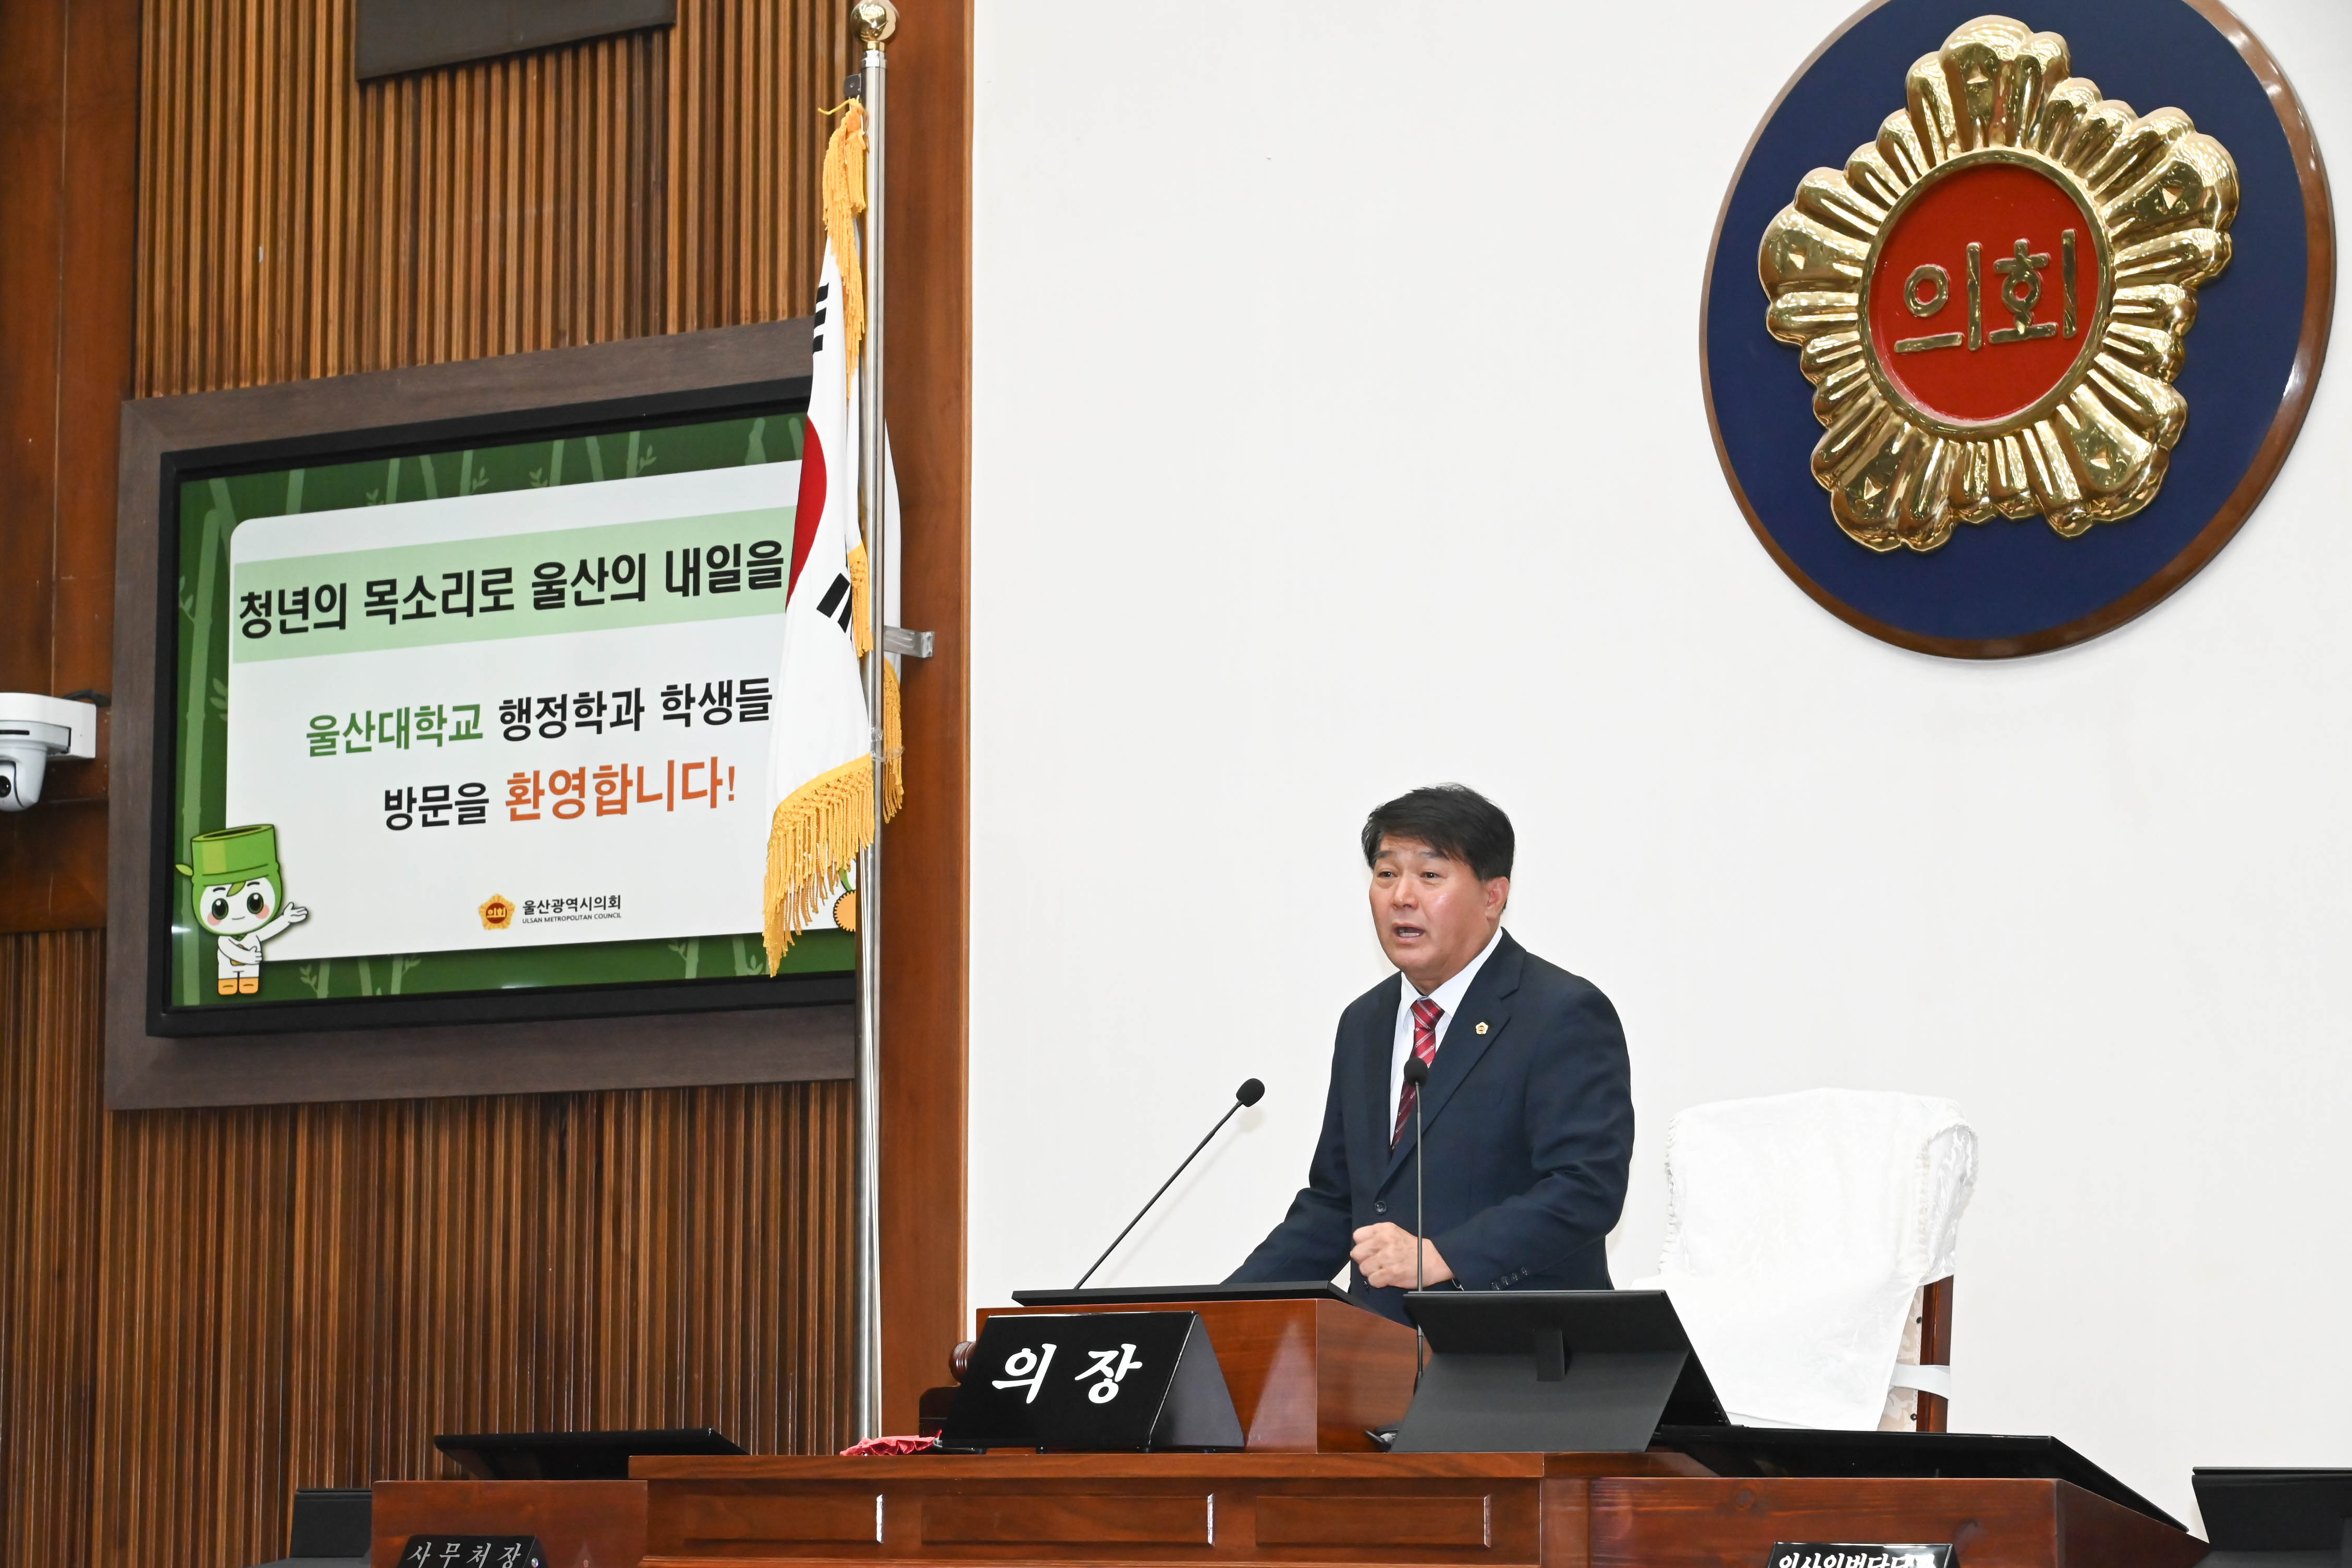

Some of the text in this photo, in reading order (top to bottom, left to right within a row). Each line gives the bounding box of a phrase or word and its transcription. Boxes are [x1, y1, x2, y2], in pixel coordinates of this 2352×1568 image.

[1894, 228, 2077, 353] 의회
[239, 540, 784, 639] 청년의 목소리로 울산의 내일을
[307, 678, 773, 757] 울산대학교 행정학과 학생들
[384, 756, 735, 831] 방문을 환영합니다!
[522, 895, 621, 915] 울산광역시의회
